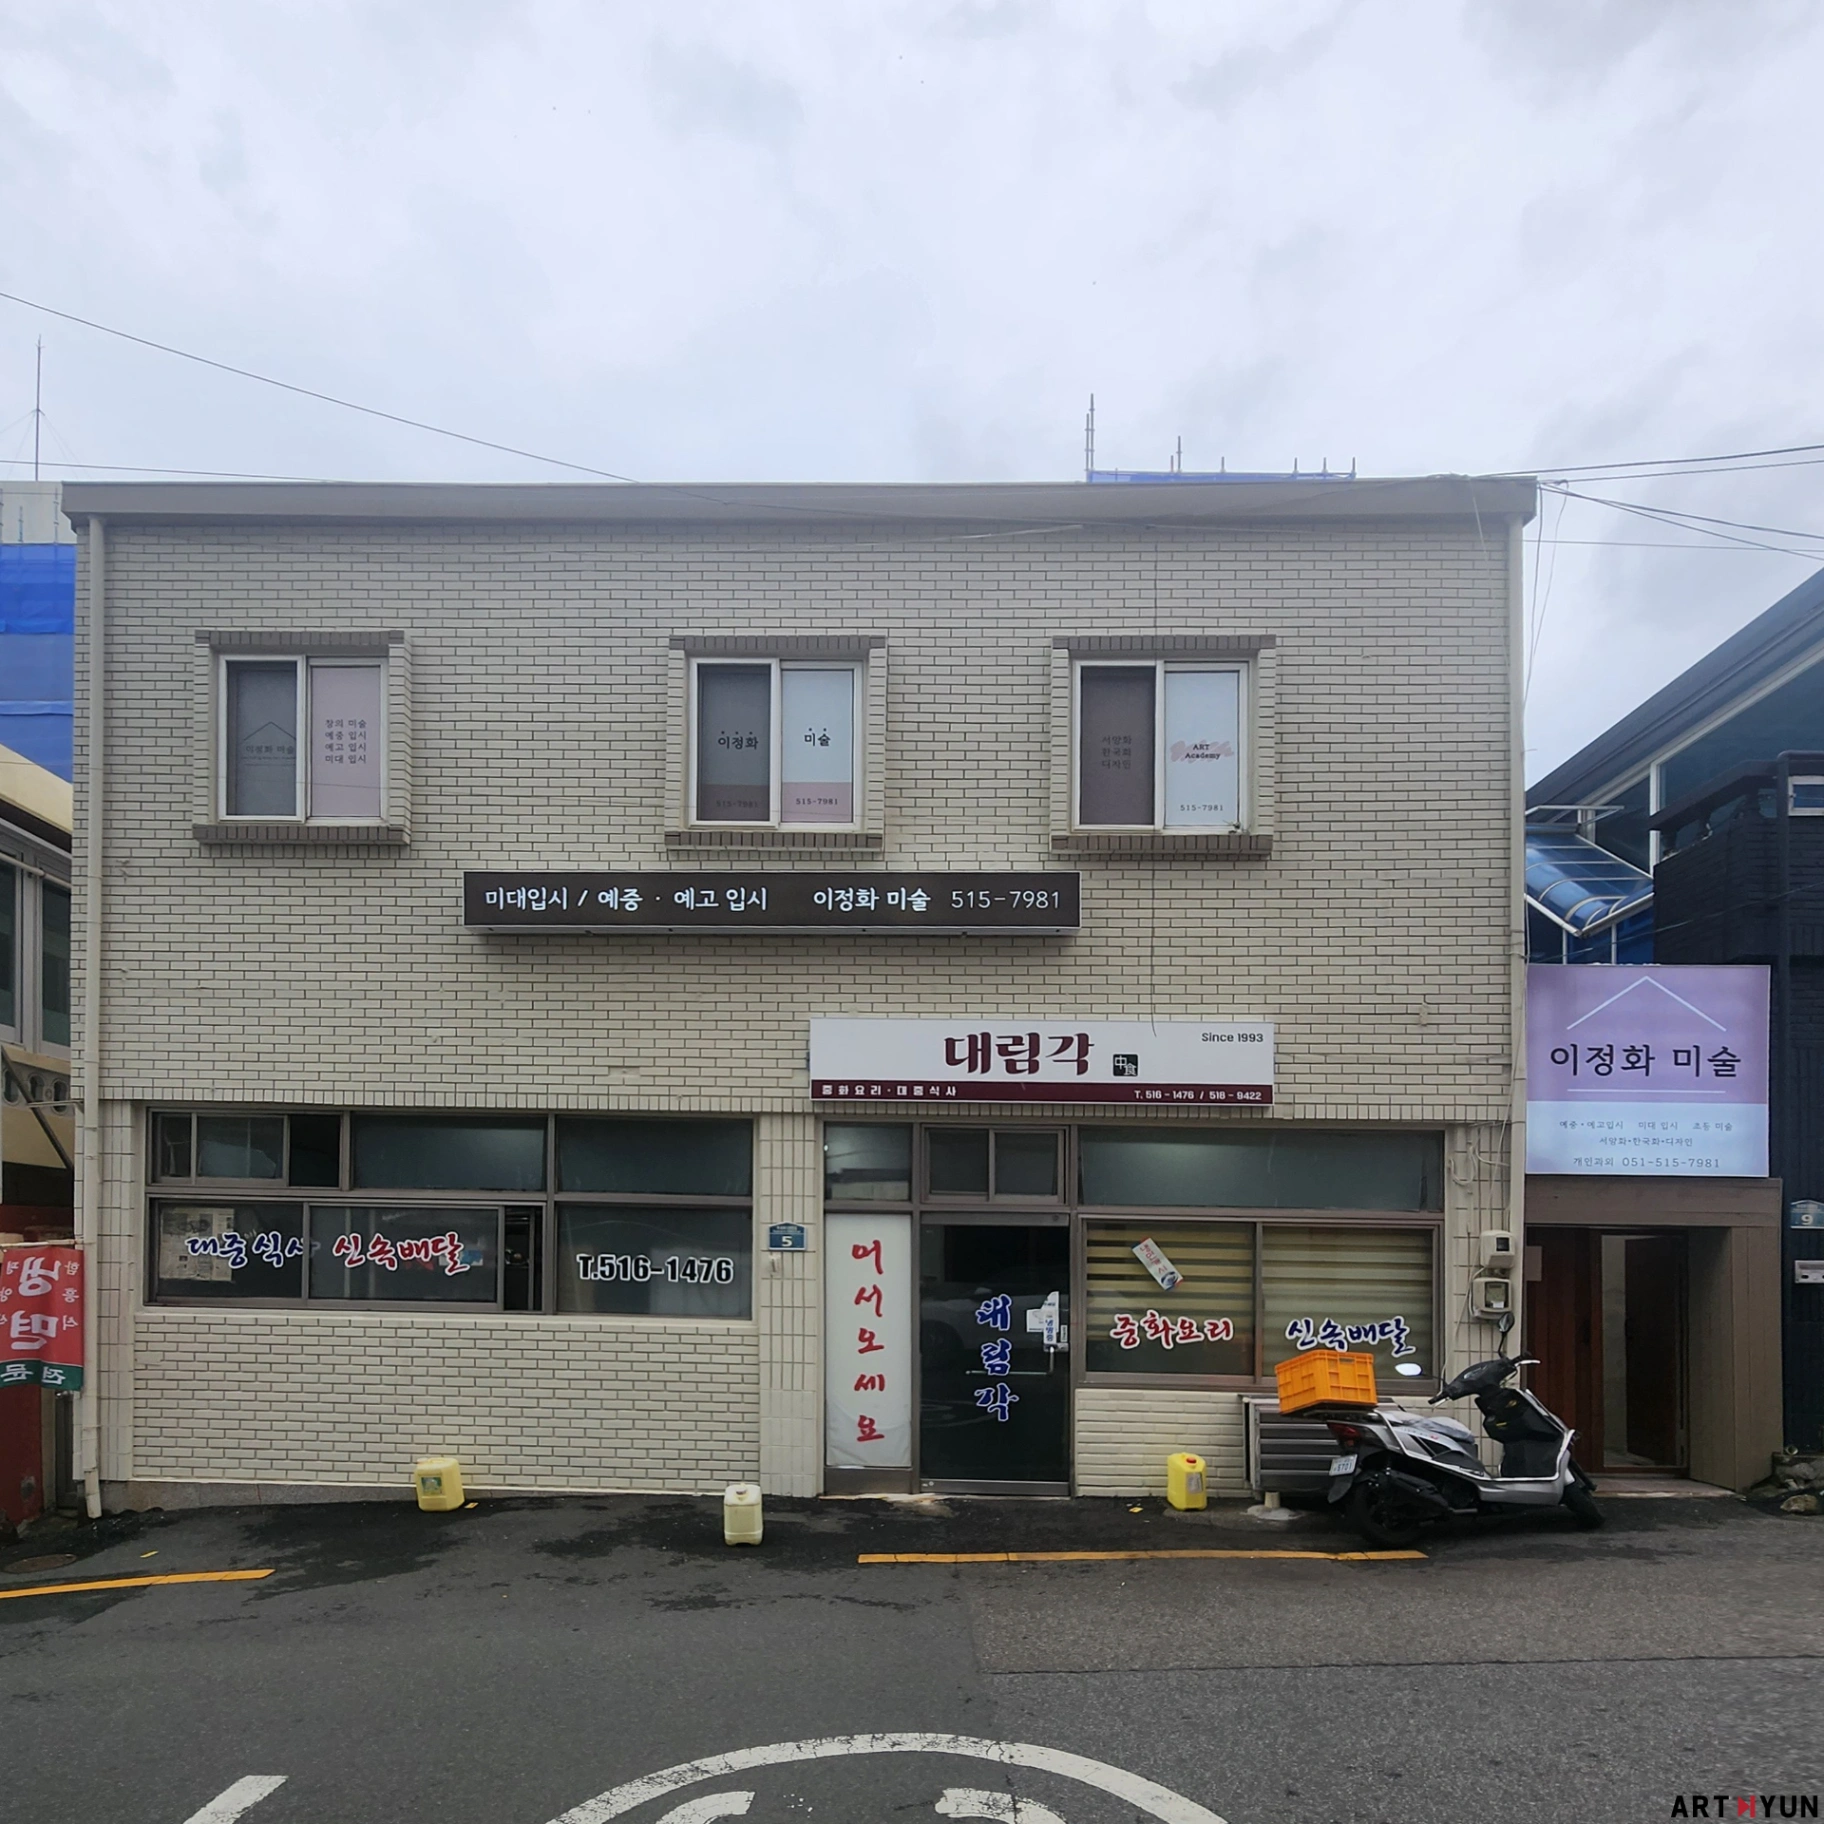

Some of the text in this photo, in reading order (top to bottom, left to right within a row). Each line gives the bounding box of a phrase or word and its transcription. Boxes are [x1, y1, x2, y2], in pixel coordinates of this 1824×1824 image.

[325, 719, 367, 729] 창의 미술
[325, 731, 367, 741] 예중 입시
[804, 733, 831, 747] 미술
[325, 743, 367, 752] 예고 입시
[718, 736, 759, 750] 이정화
[325, 754, 367, 764] 미대 입시
[1185, 752, 1221, 760] Academy
[796, 798, 838, 806] 515-7981
[1180, 804, 1224, 812] 515-7981
[485, 886, 568, 911] 미대입시
[597, 886, 643, 911] 예중
[673, 886, 719, 911] 예고
[725, 886, 767, 911] 입시
[813, 886, 880, 912] 이정화
[886, 887, 931, 912] 미술
[950, 890, 1060, 909] 515-7981
[1201, 1032, 1264, 1043] Since 1993
[944, 1032, 1095, 1076] 대림각
[1550, 1043, 1742, 1078] 이정화 미술
[1638, 1121, 1656, 1130] 미대
[1661, 1121, 1678, 1131] 입시
[1715, 1122, 1733, 1131] 미술
[1573, 1157, 1720, 1168] 개인과외 051-515-7981
[1801, 1214, 1813, 1225] 9
[782, 1235, 792, 1247] 5
[333, 1231, 470, 1276] 신속배달
[577, 1253, 734, 1284] T.516-1476
[1110, 1310, 1416, 1357] 중화요리 신속배달
[851, 1240, 885, 1442] 어서오세요
[974, 1294, 1020, 1422] 대림각
